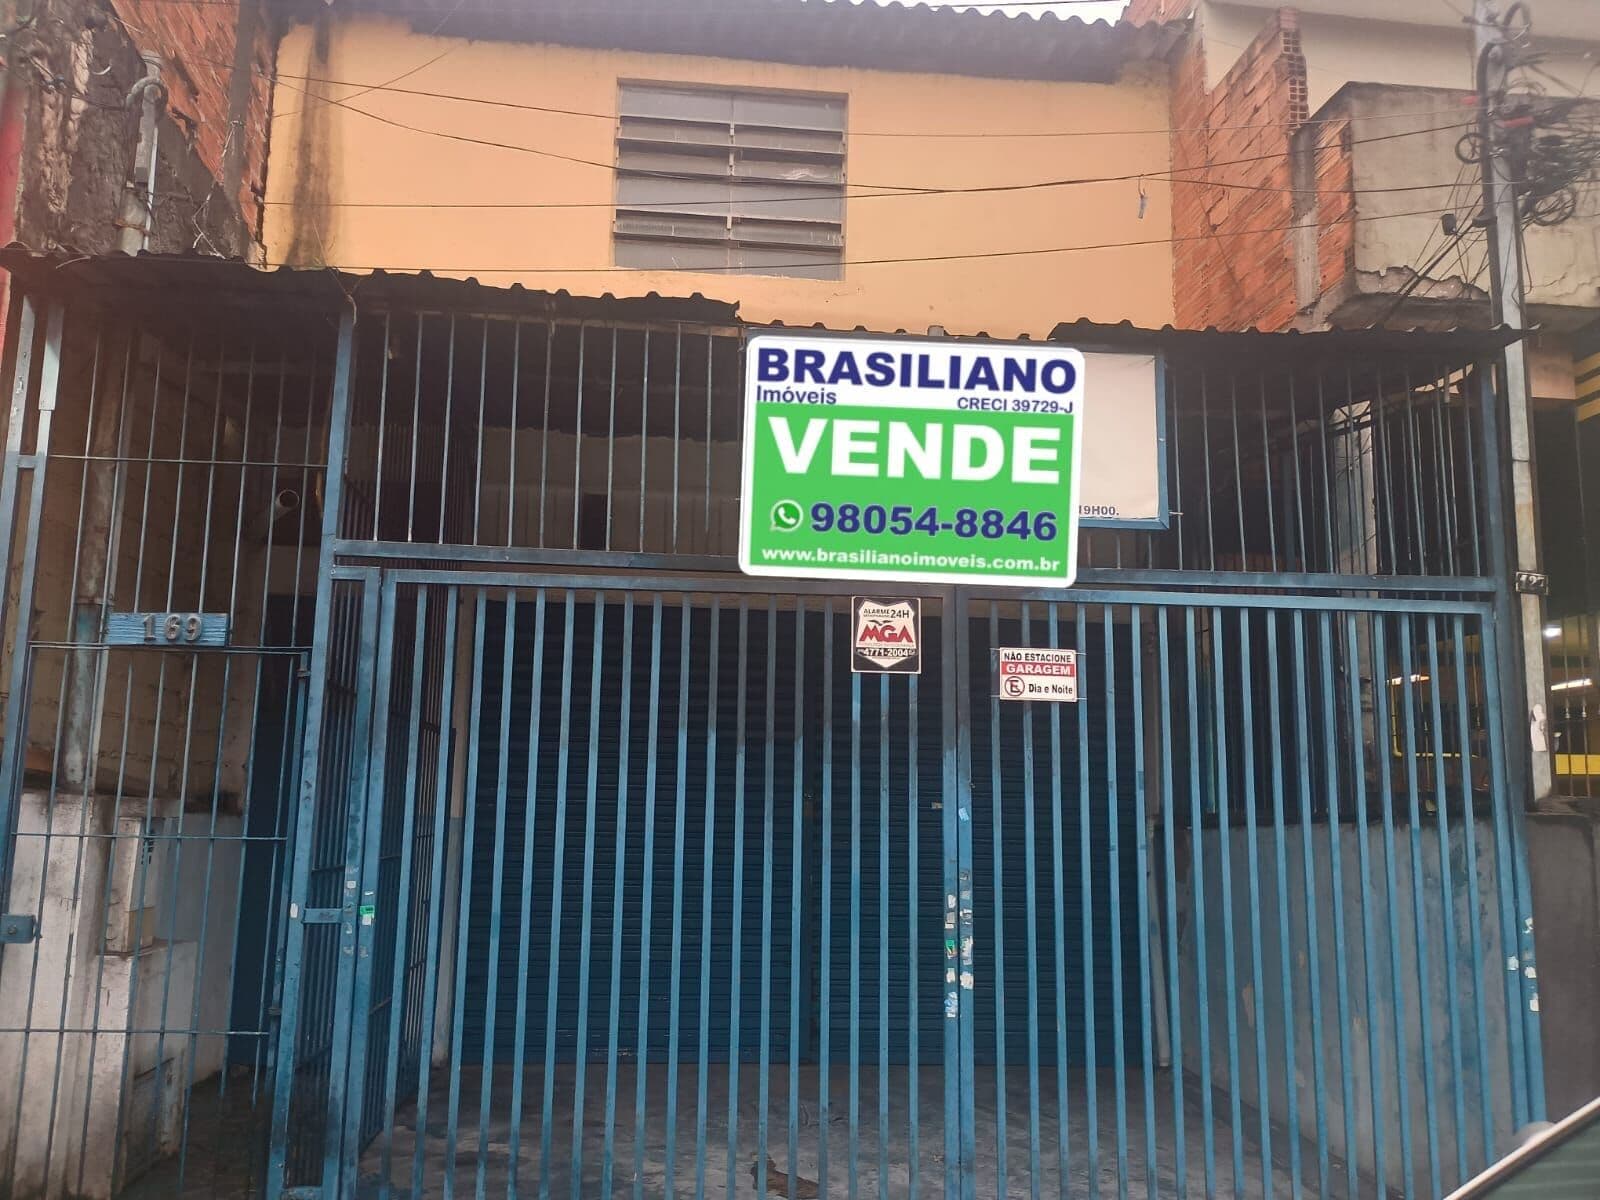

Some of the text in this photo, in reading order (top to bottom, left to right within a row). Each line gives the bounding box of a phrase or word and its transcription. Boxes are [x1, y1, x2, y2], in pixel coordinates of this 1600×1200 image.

[890, 609, 910, 618] 24H
[143, 614, 201, 641] 169
[859, 624, 913, 642] MGA
[863, 648, 908, 657] 4771-2004
[1004, 651, 1072, 663] NÃO ESTACIONE
[1006, 664, 1071, 675] GARAGEM
[1028, 683, 1073, 695] Dia e Noite
